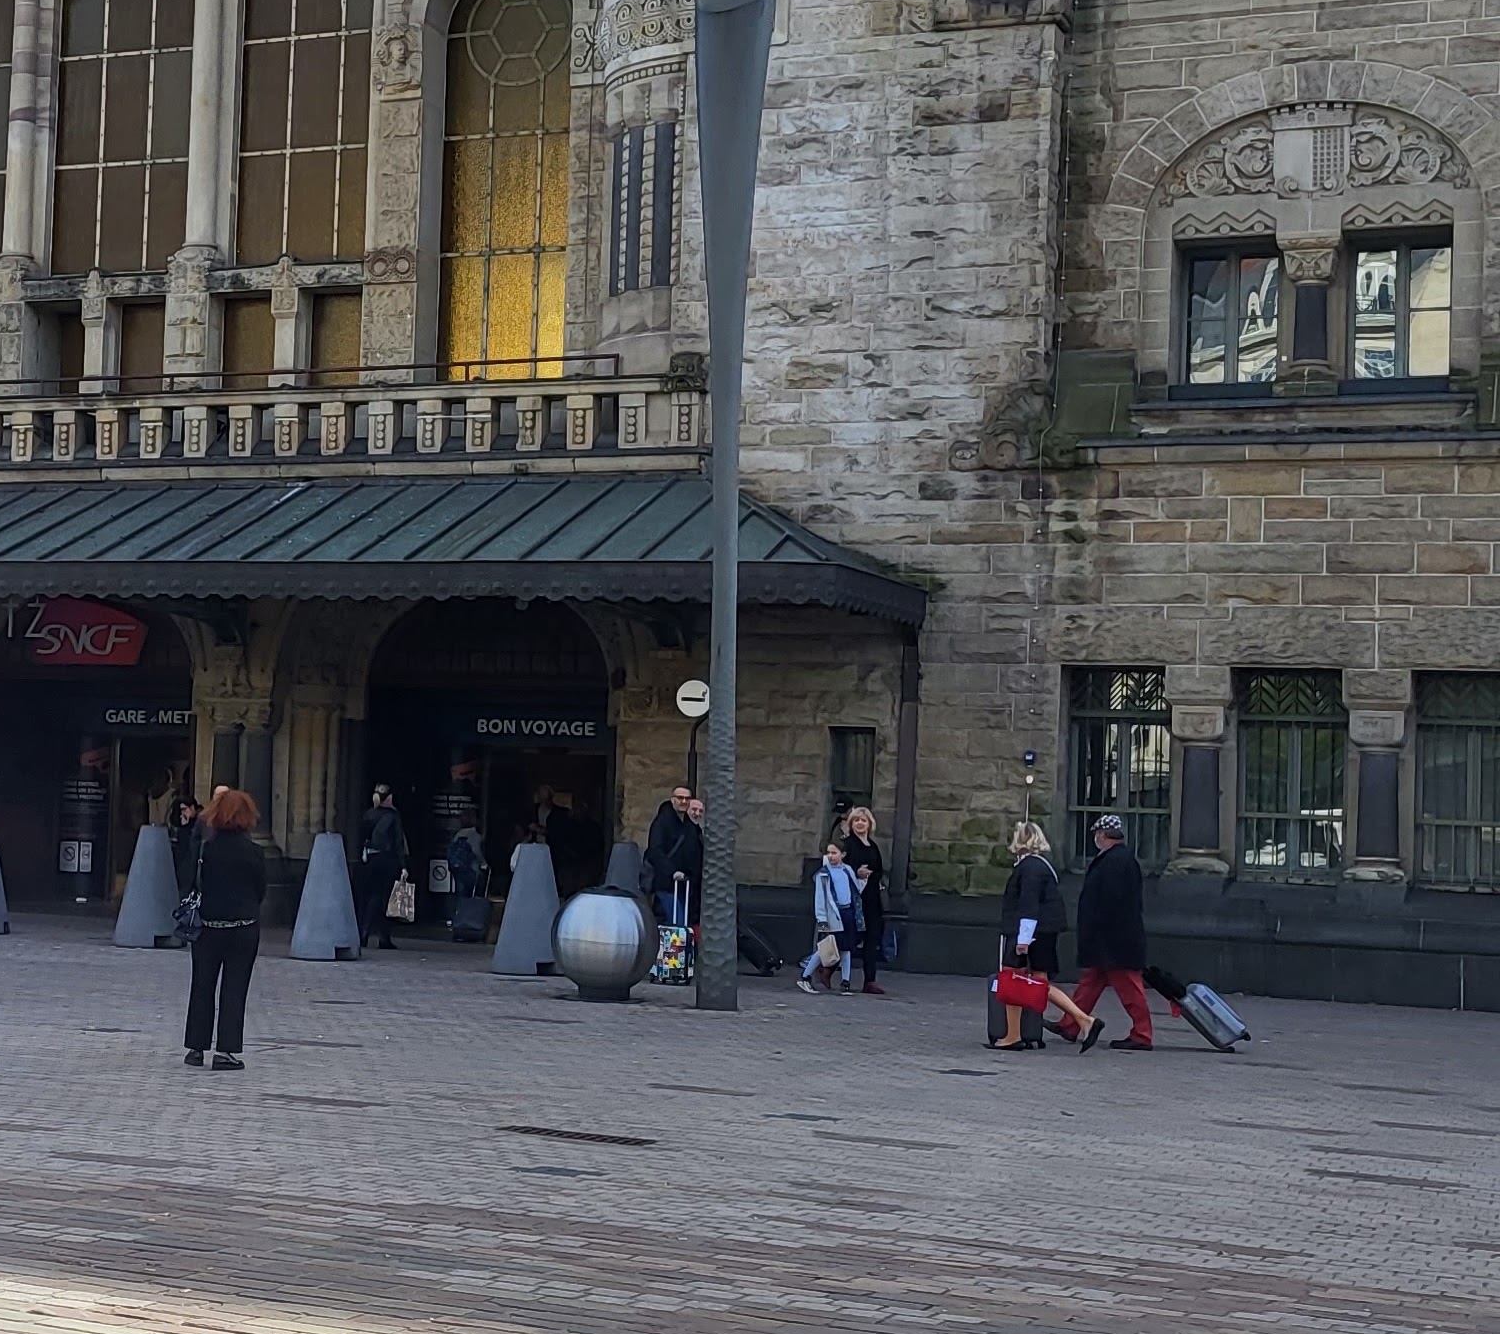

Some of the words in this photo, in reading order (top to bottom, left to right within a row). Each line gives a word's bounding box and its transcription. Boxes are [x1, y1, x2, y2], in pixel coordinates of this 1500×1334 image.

[35, 624, 137, 656] SNCF
[105, 708, 147, 724] GARE
[158, 709, 192, 725] MET
[476, 718, 516, 734] BON
[520, 719, 597, 736] VOYAGE
